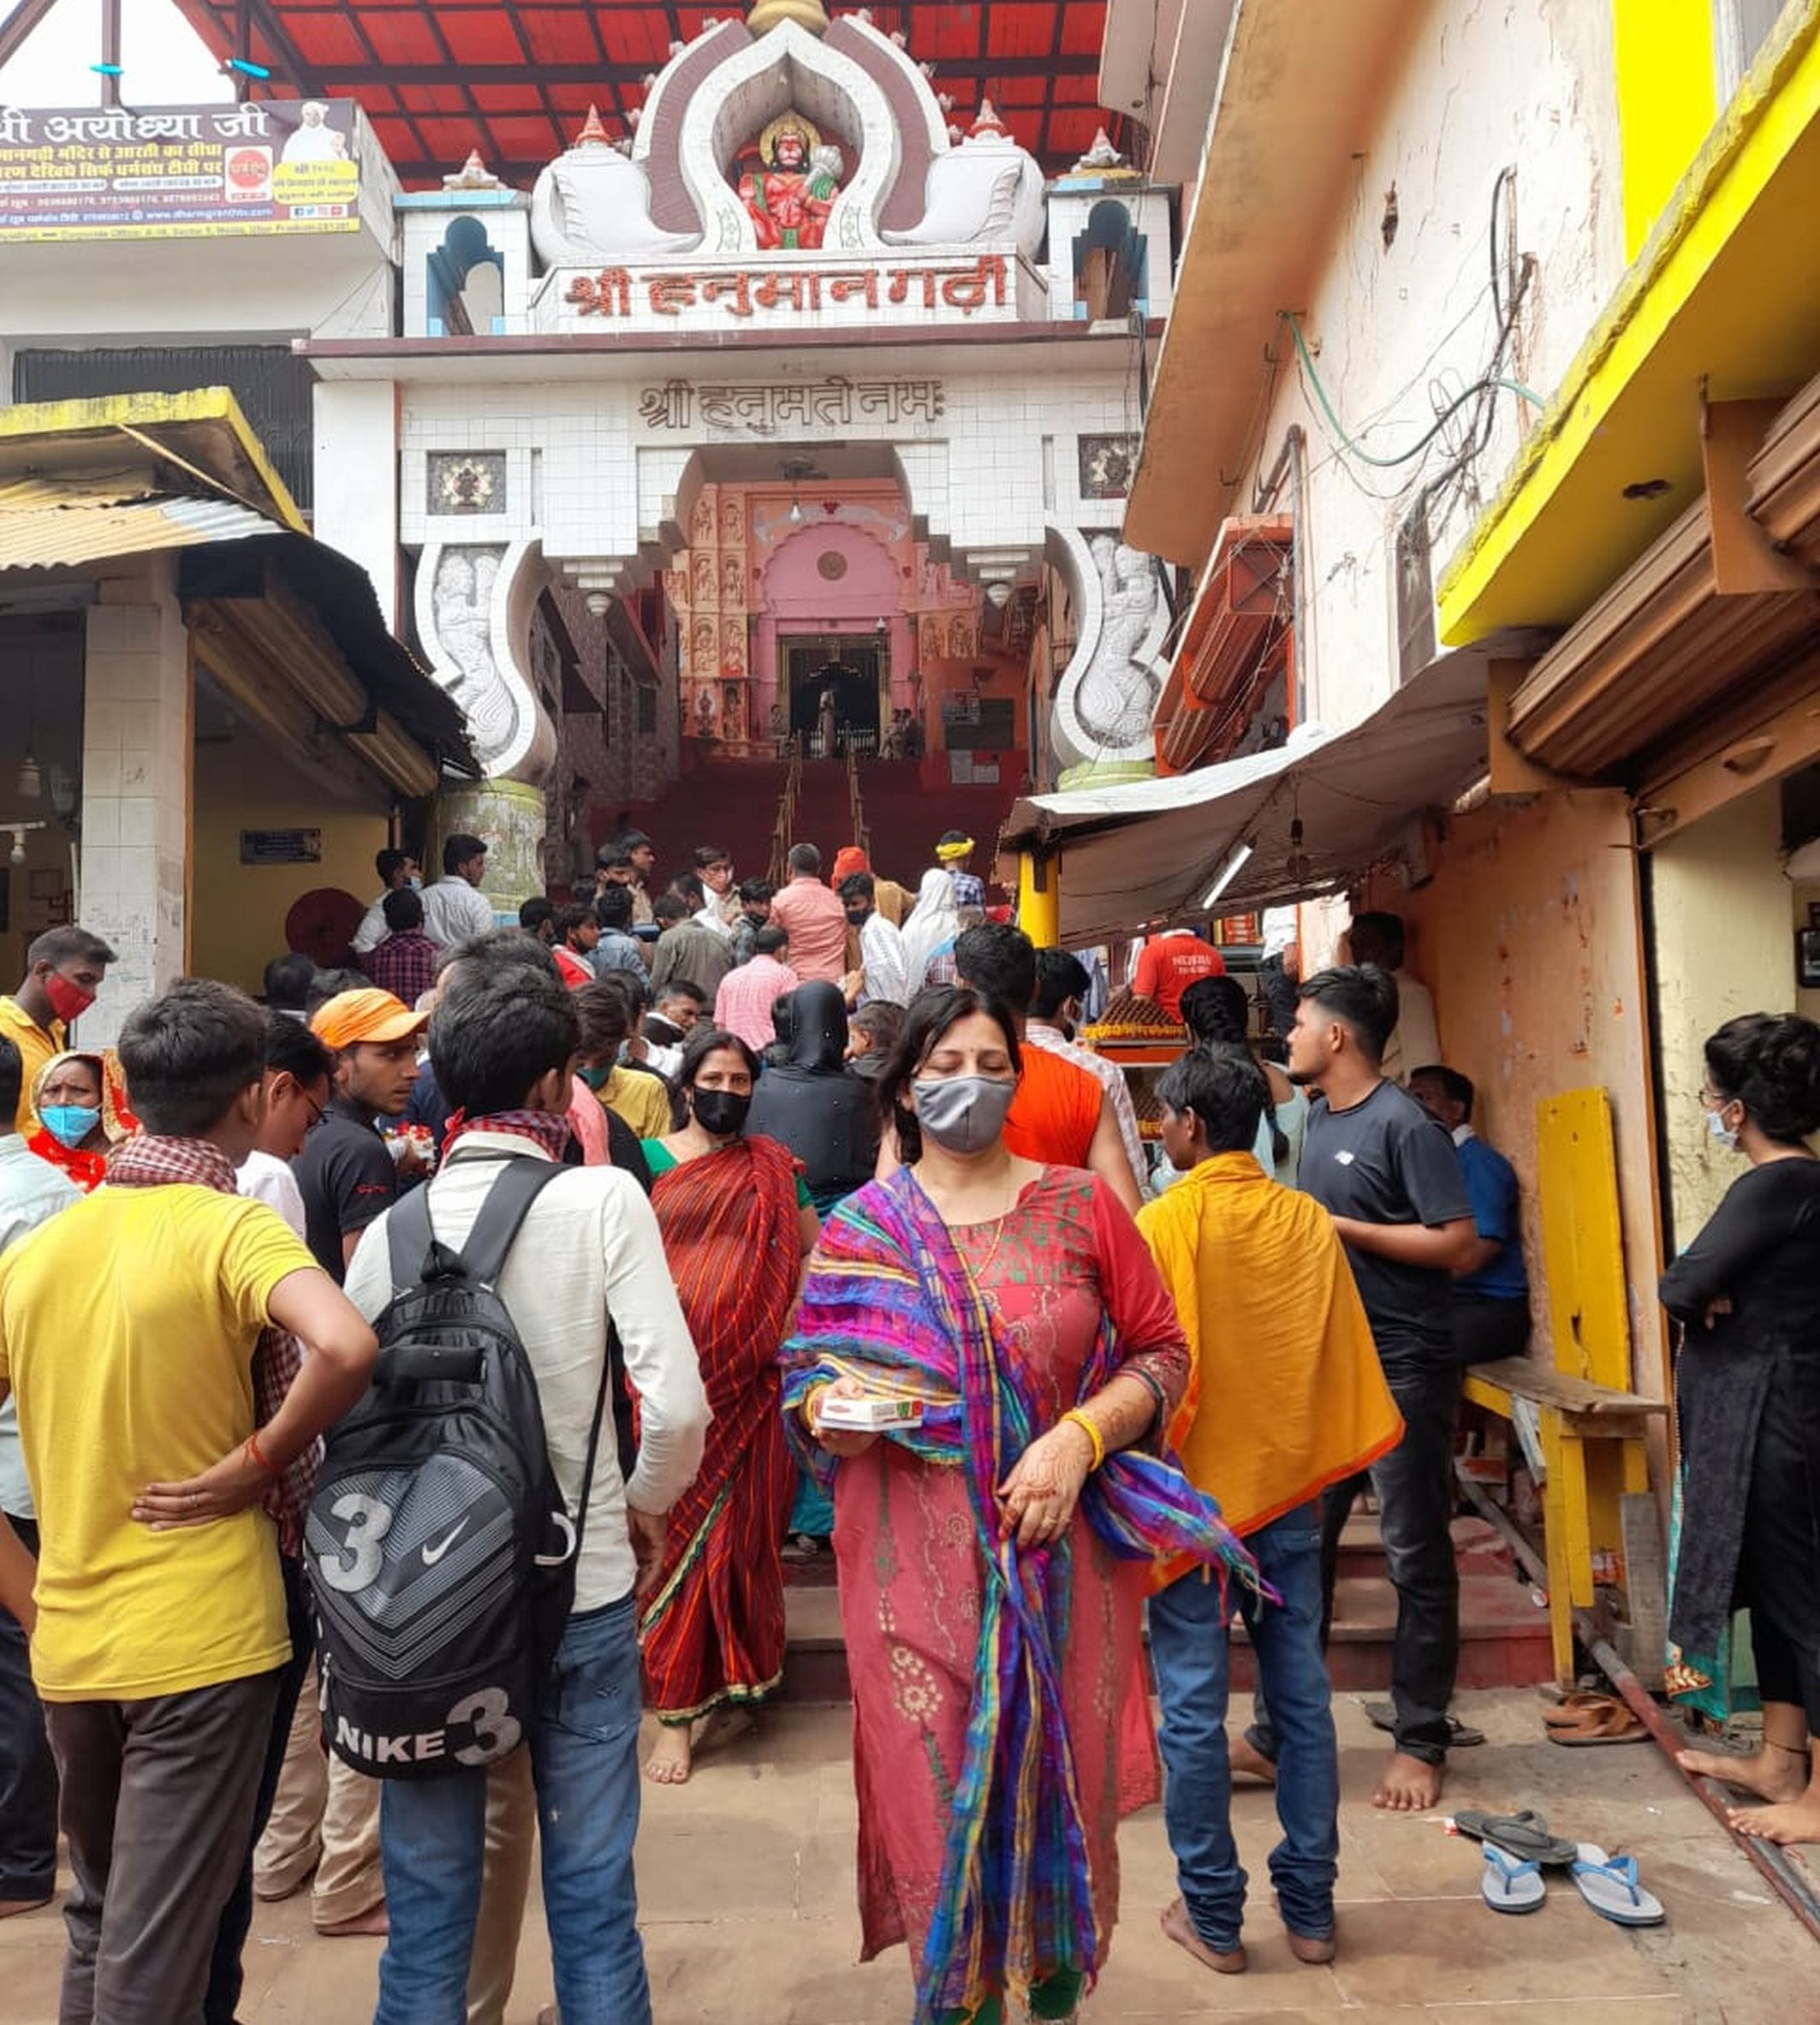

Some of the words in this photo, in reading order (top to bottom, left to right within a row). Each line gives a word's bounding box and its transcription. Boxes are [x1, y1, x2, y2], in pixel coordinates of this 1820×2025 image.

[44, 109, 203, 142] अयोध्या
[213, 103, 271, 138] जी
[565, 265, 633, 317] श्री
[638, 378, 694, 429] श्री
[858, 380, 945, 424] नमः
[319, 1492, 393, 1593] 3
[334, 1715, 446, 1763] NIKE
[445, 1686, 521, 1766] 3
